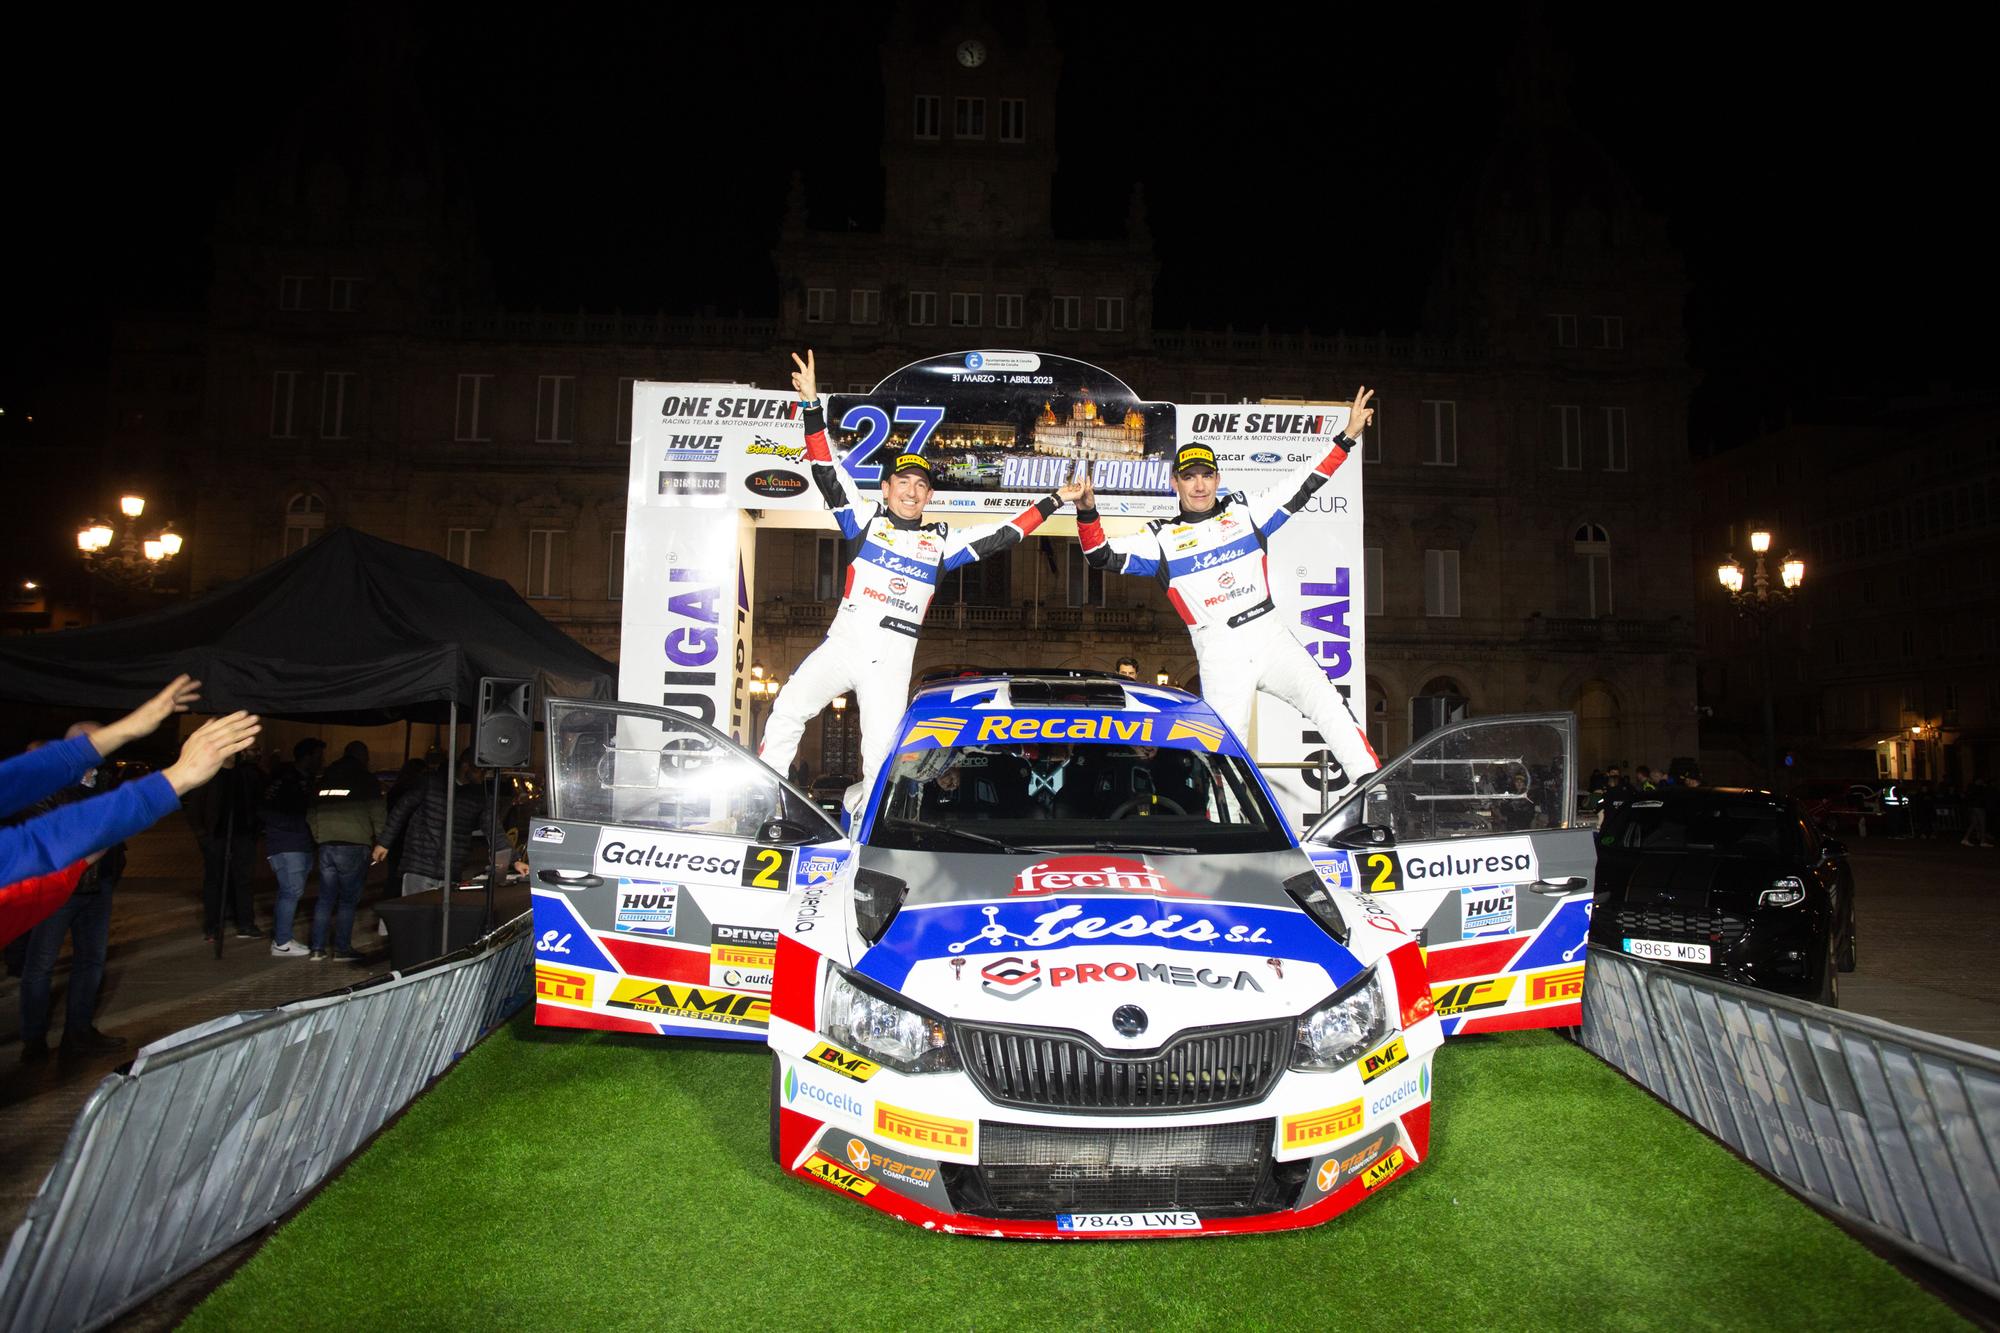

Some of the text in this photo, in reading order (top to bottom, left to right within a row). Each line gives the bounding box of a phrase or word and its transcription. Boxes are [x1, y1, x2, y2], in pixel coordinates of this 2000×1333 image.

[952, 374, 960, 382] 31
[963, 374, 995, 383] MARZO
[1003, 375, 1007, 383] 1
[1010, 375, 1032, 384] ABRIL
[1033, 376, 1053, 384] 2023
[661, 396, 712, 417] ONE
[721, 420, 773, 428] MOTORSPORT
[775, 422, 804, 430] EVENTS
[1192, 413, 1241, 433] ONE
[667, 434, 723, 449] HVC
[839, 404, 945, 482] 27
[1216, 454, 1246, 462] zacar
[1256, 455, 1277, 463] Ford
[755, 477, 801, 487] Da Cunha
[1003, 457, 1170, 490] RALLYE A CORUÑA
[984, 498, 1003, 507] ONE
[1298, 496, 1348, 513] CUR
[863, 586, 919, 614] PROMEGA
[1204, 584, 1257, 608] PROMEGA
[976, 716, 1154, 743] Recalvi
[601, 841, 784, 888] Galuresa 2
[1367, 853, 1532, 892] 2 Galuresa
[1016, 862, 1168, 893] fechi
[621, 894, 676, 909] HVC
[1465, 896, 1514, 917] HVC
[1027, 905, 1221, 947] tesis
[536, 929, 572, 955] S.L.
[1634, 943, 1707, 960] 9865 MDS
[1050, 962, 1264, 994] PROMEGA
[633, 1002, 743, 1026] MOTORSPORT
[800, 1080, 863, 1117] ecocelta
[1372, 1080, 1417, 1115] ecocelta
[877, 1107, 969, 1149] PIRELLI
[1286, 1104, 1362, 1143] PIRELLI
[871, 1153, 936, 1183] staroil
[882, 1169, 930, 1189] COMPETICION
[1076, 1213, 1197, 1228] 7849 LWS
